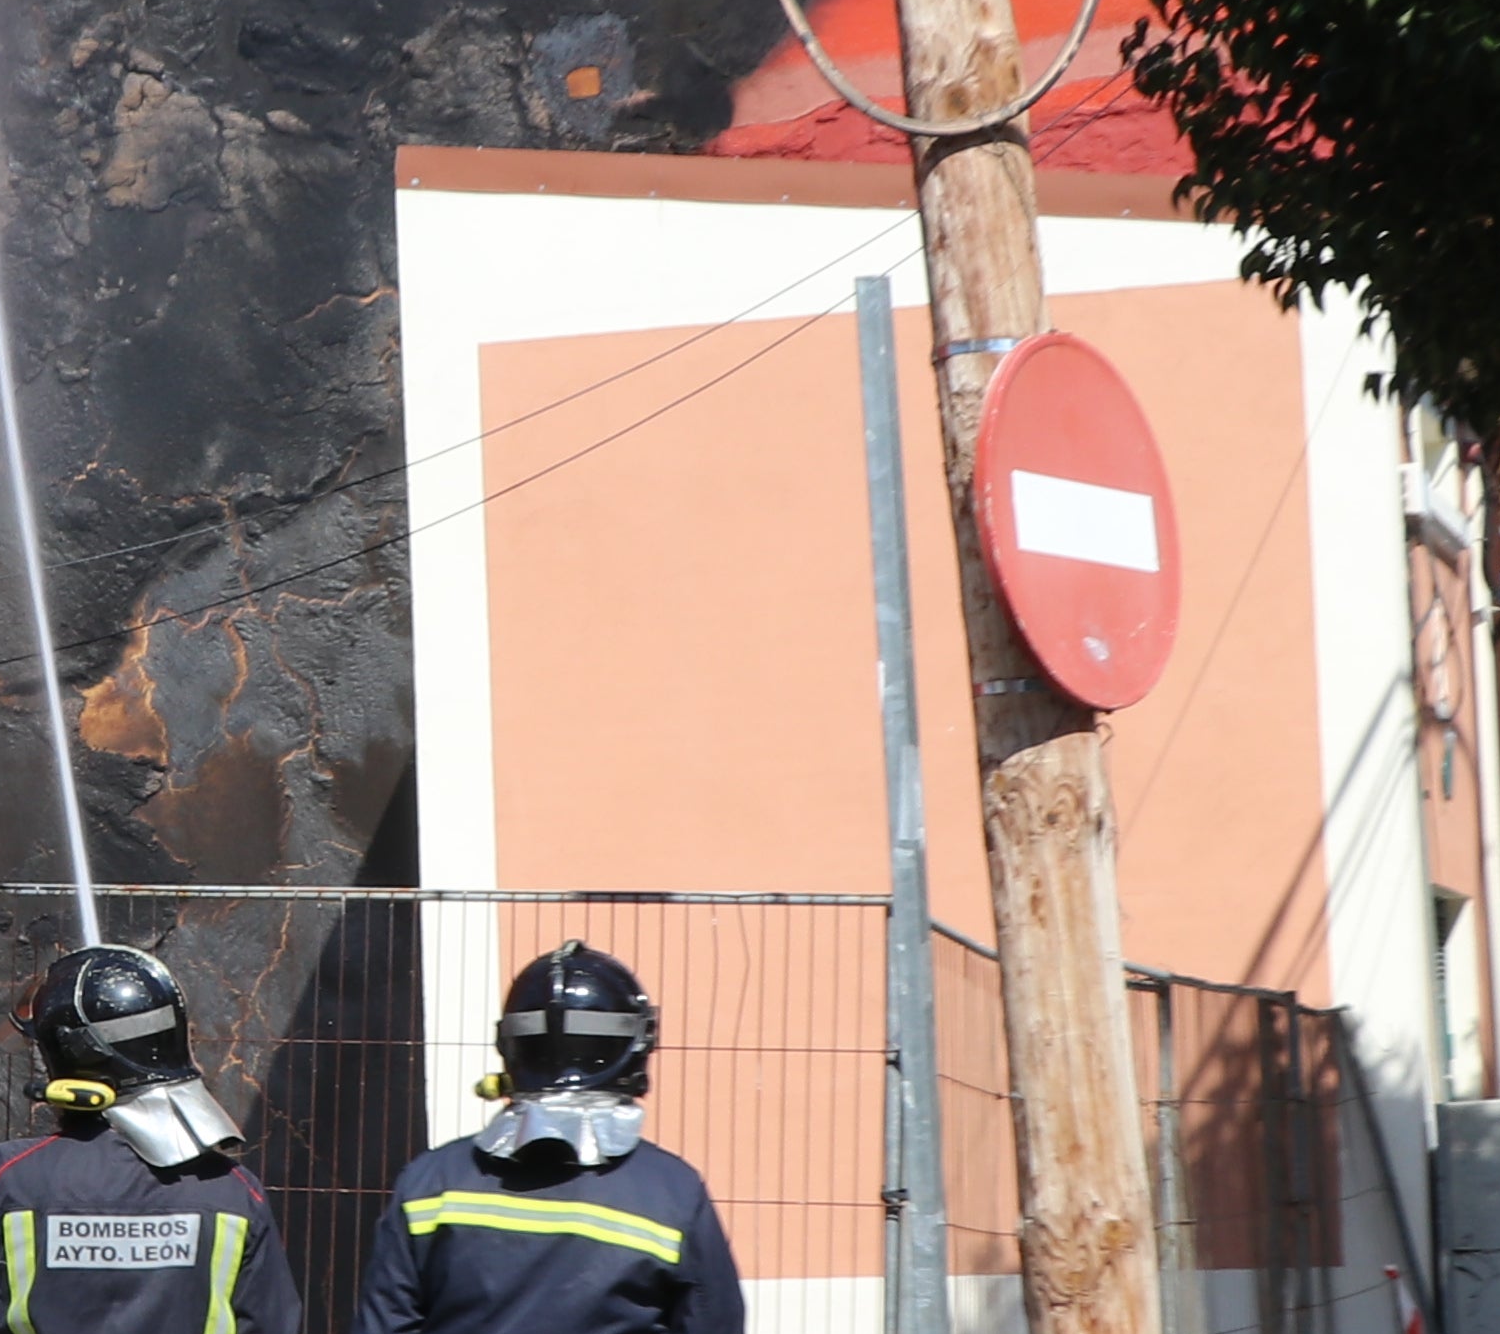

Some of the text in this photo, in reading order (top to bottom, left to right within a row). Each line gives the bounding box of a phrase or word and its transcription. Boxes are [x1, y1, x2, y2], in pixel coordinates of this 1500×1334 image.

[58, 1219, 189, 1239] BOMBEROS
[54, 1240, 191, 1262] AYTO. LEÓN
